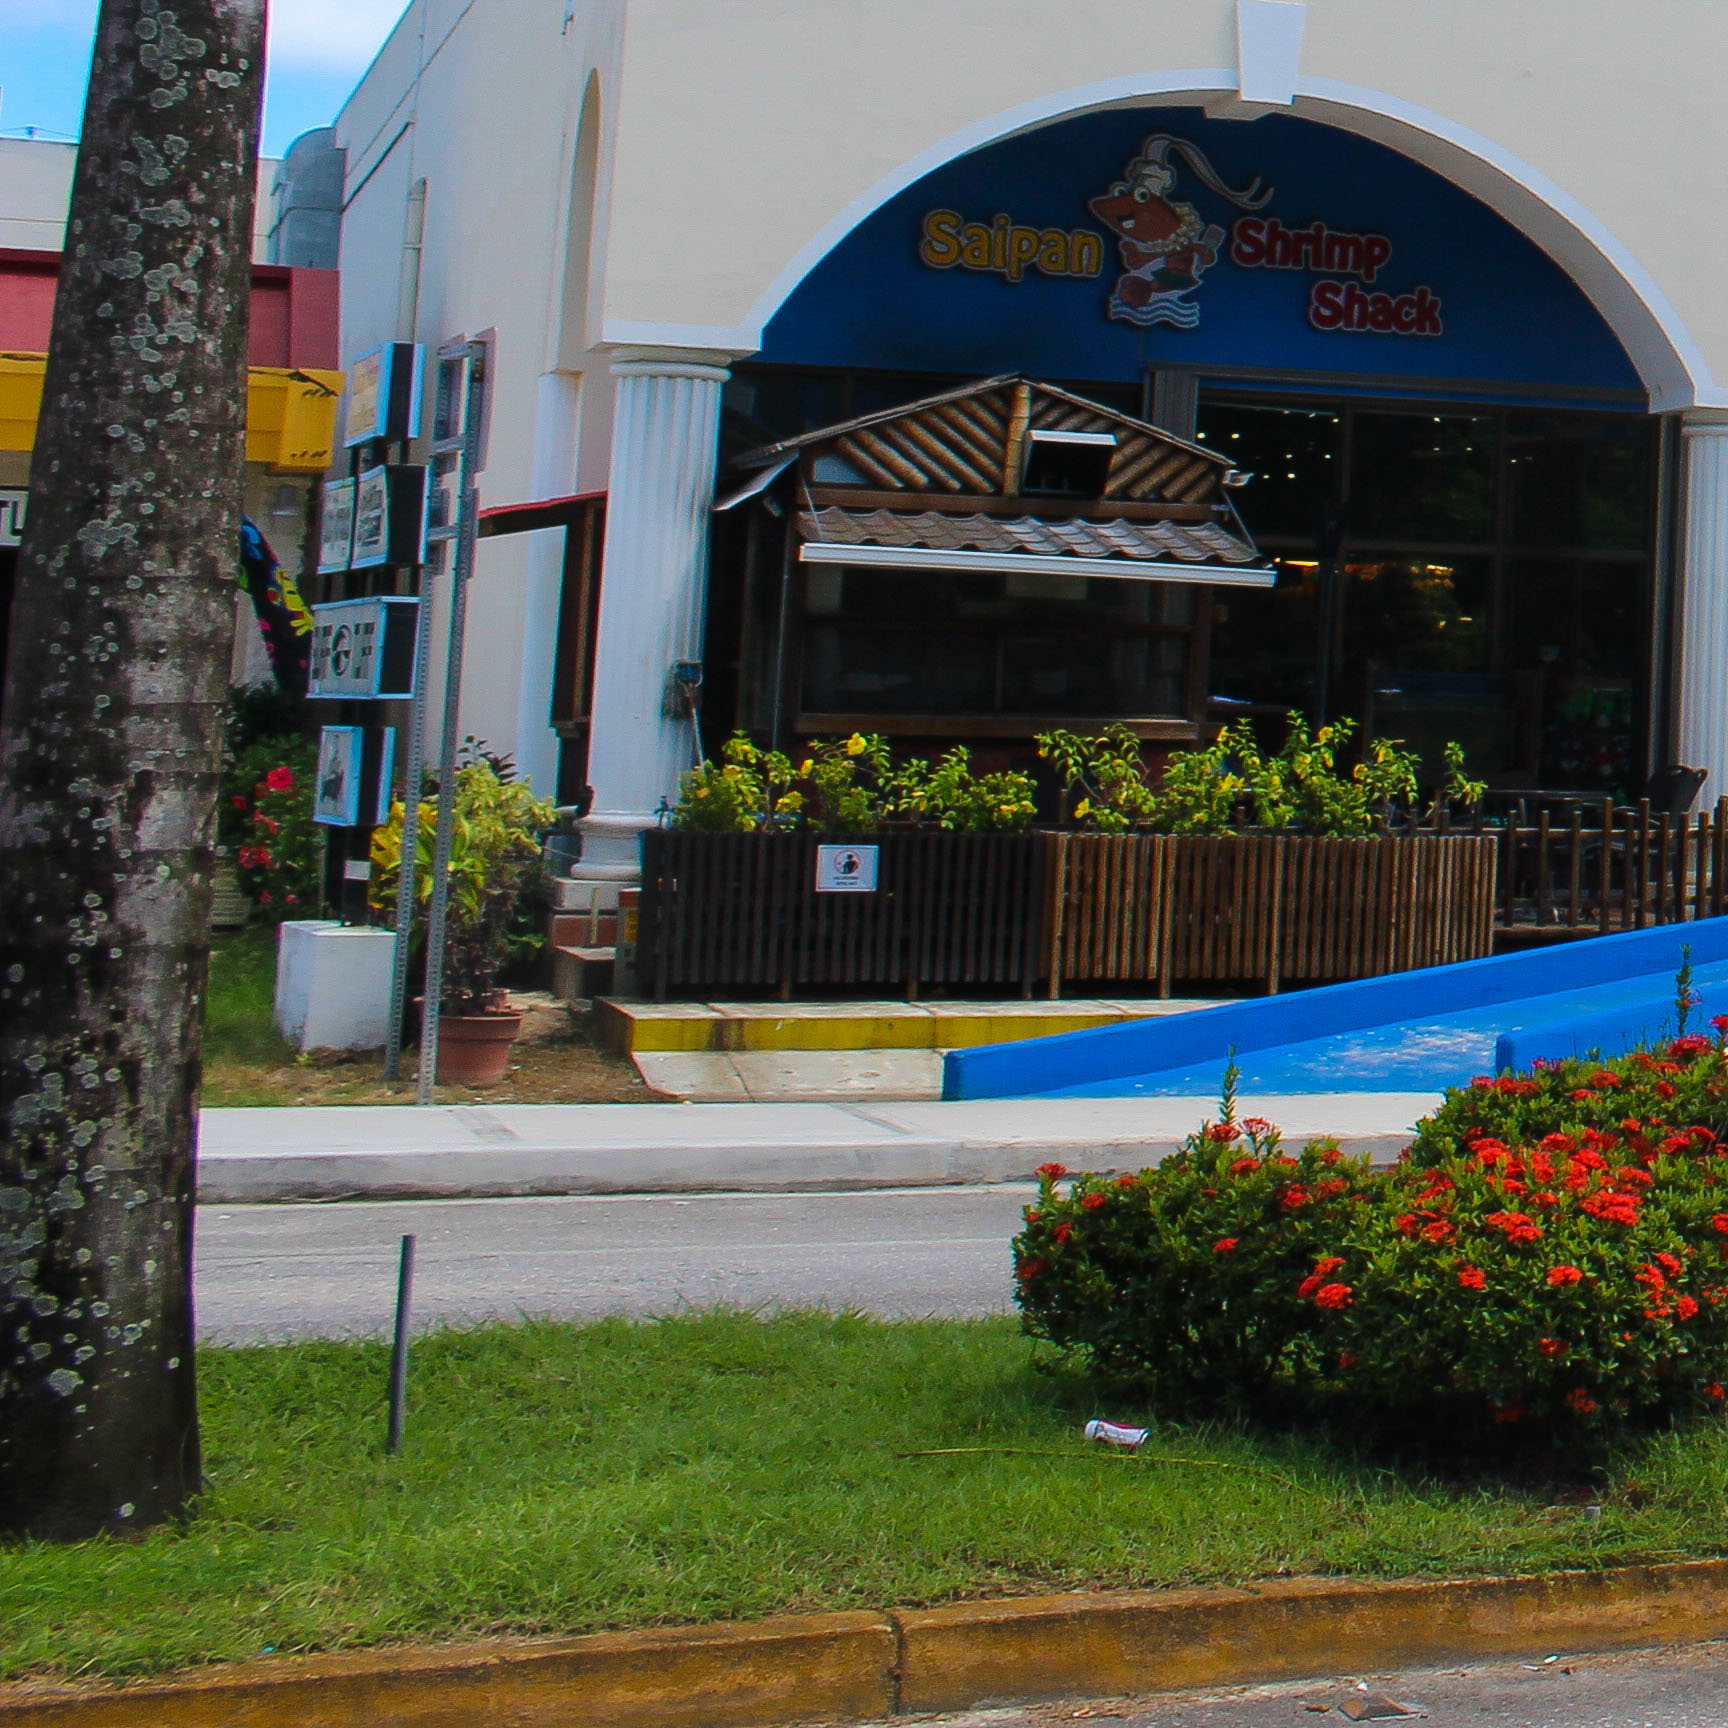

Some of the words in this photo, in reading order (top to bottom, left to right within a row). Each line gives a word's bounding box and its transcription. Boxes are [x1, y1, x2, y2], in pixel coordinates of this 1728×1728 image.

[920, 209, 1104, 283] Saipan
[1230, 216, 1392, 282] Shrimp
[1308, 279, 1443, 336] Shack
